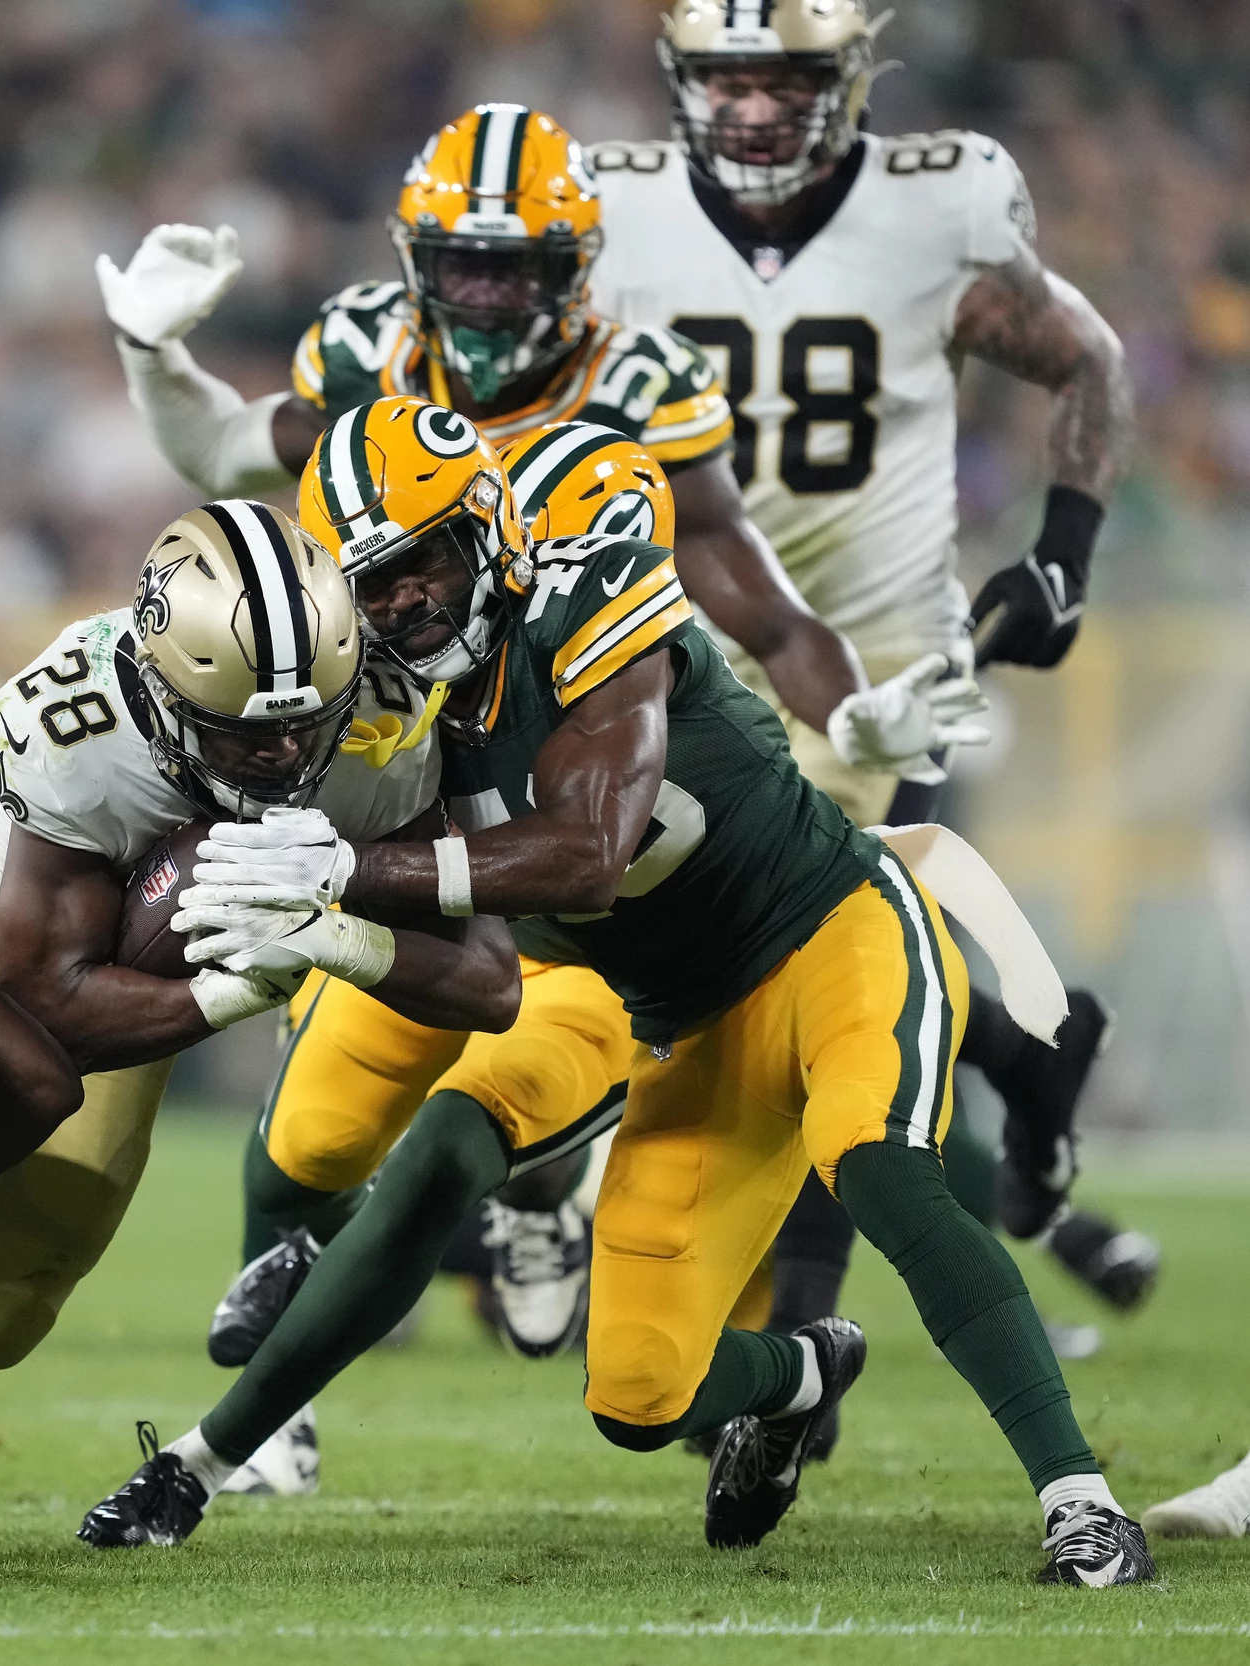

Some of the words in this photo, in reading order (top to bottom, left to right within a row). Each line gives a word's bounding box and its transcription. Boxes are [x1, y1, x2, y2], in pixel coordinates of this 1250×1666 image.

[417, 405, 477, 455] G
[349, 531, 386, 558] PACKERS
[14, 648, 120, 749] 28
[265, 696, 305, 709] SAINTS
[143, 864, 175, 901] NFL
